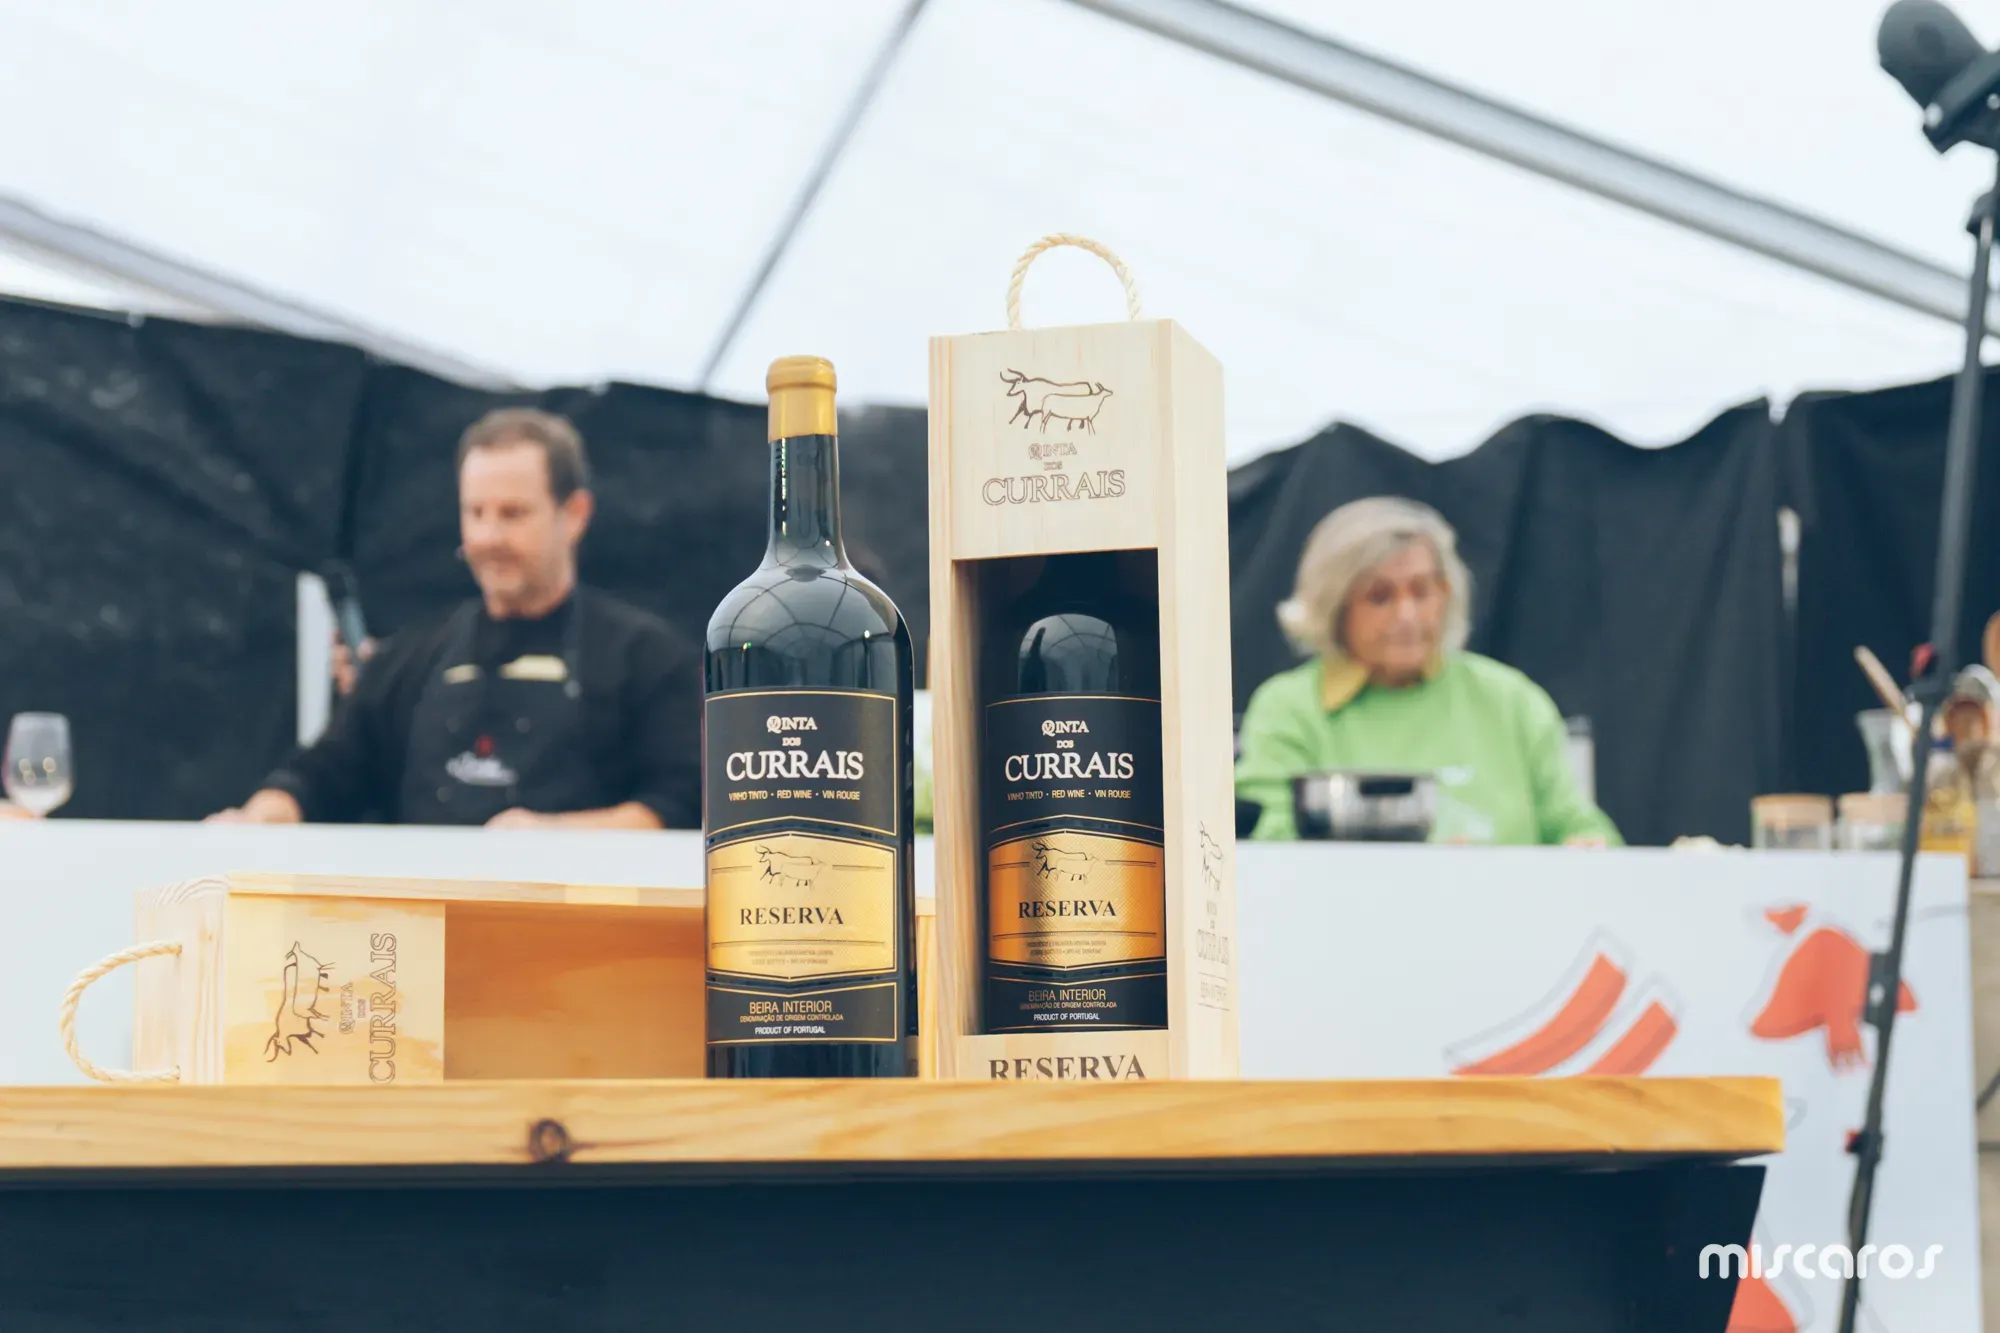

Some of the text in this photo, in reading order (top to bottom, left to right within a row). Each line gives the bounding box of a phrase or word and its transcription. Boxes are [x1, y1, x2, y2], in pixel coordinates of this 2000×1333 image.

[982, 469, 1126, 506] CURRAIS
[782, 737, 801, 746] DOS
[1056, 740, 1074, 748] DOS
[726, 750, 864, 781] CURRAIS
[1005, 751, 1134, 782] CURRAIS
[729, 789, 860, 801] VINHO TINTO RED WINE VIN ROUGE
[1007, 789, 1132, 801] VINHO TINTO RED WINE VIN ROUGE
[740, 906, 844, 925] RESERVA
[1018, 899, 1117, 919] RESERVA
[1028, 988, 1107, 1002] BEIRA INTERIOR
[369, 932, 396, 1084] CURRAIS
[749, 1000, 832, 1014] BEIRA INTERIOR
[1082, 1001, 1117, 1009] CONTROLADA
[807, 1013, 844, 1021] CONTROLADA
[1033, 1012, 1100, 1021] PRODUCT OF PORTUGAL
[755, 1025, 826, 1034] PRODUCT OF PORTUGAL
[988, 1054, 1147, 1080] RESERVA
